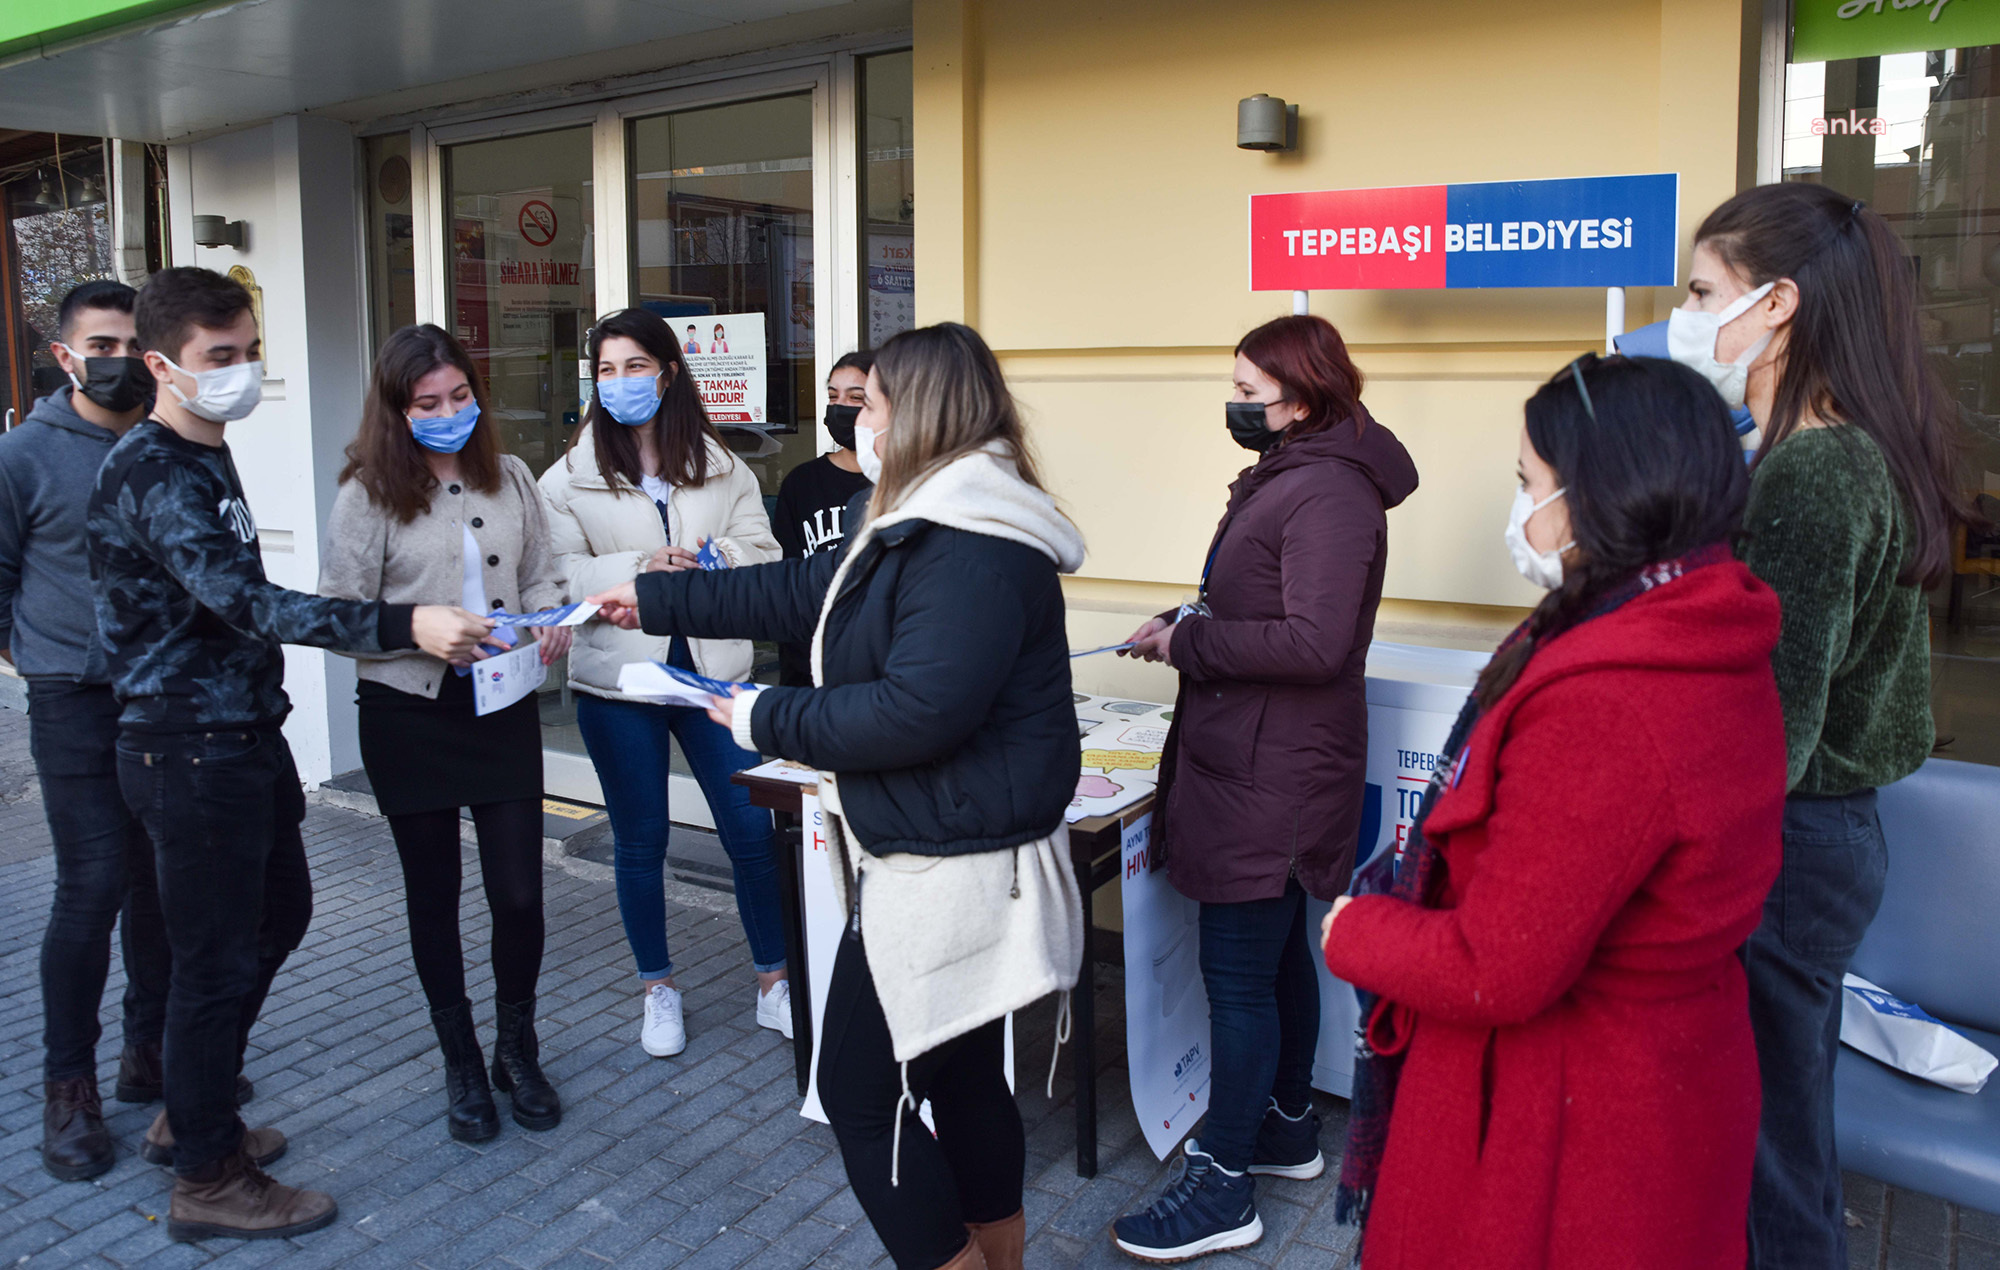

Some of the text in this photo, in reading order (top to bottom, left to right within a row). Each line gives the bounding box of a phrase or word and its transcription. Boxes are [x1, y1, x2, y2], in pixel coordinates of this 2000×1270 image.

[1283, 225, 1432, 261] TEPEBAŞI
[703, 379, 748, 391] TAKMAK
[700, 392, 744, 404] NLUDUR!
[1126, 846, 1150, 880] HIV
